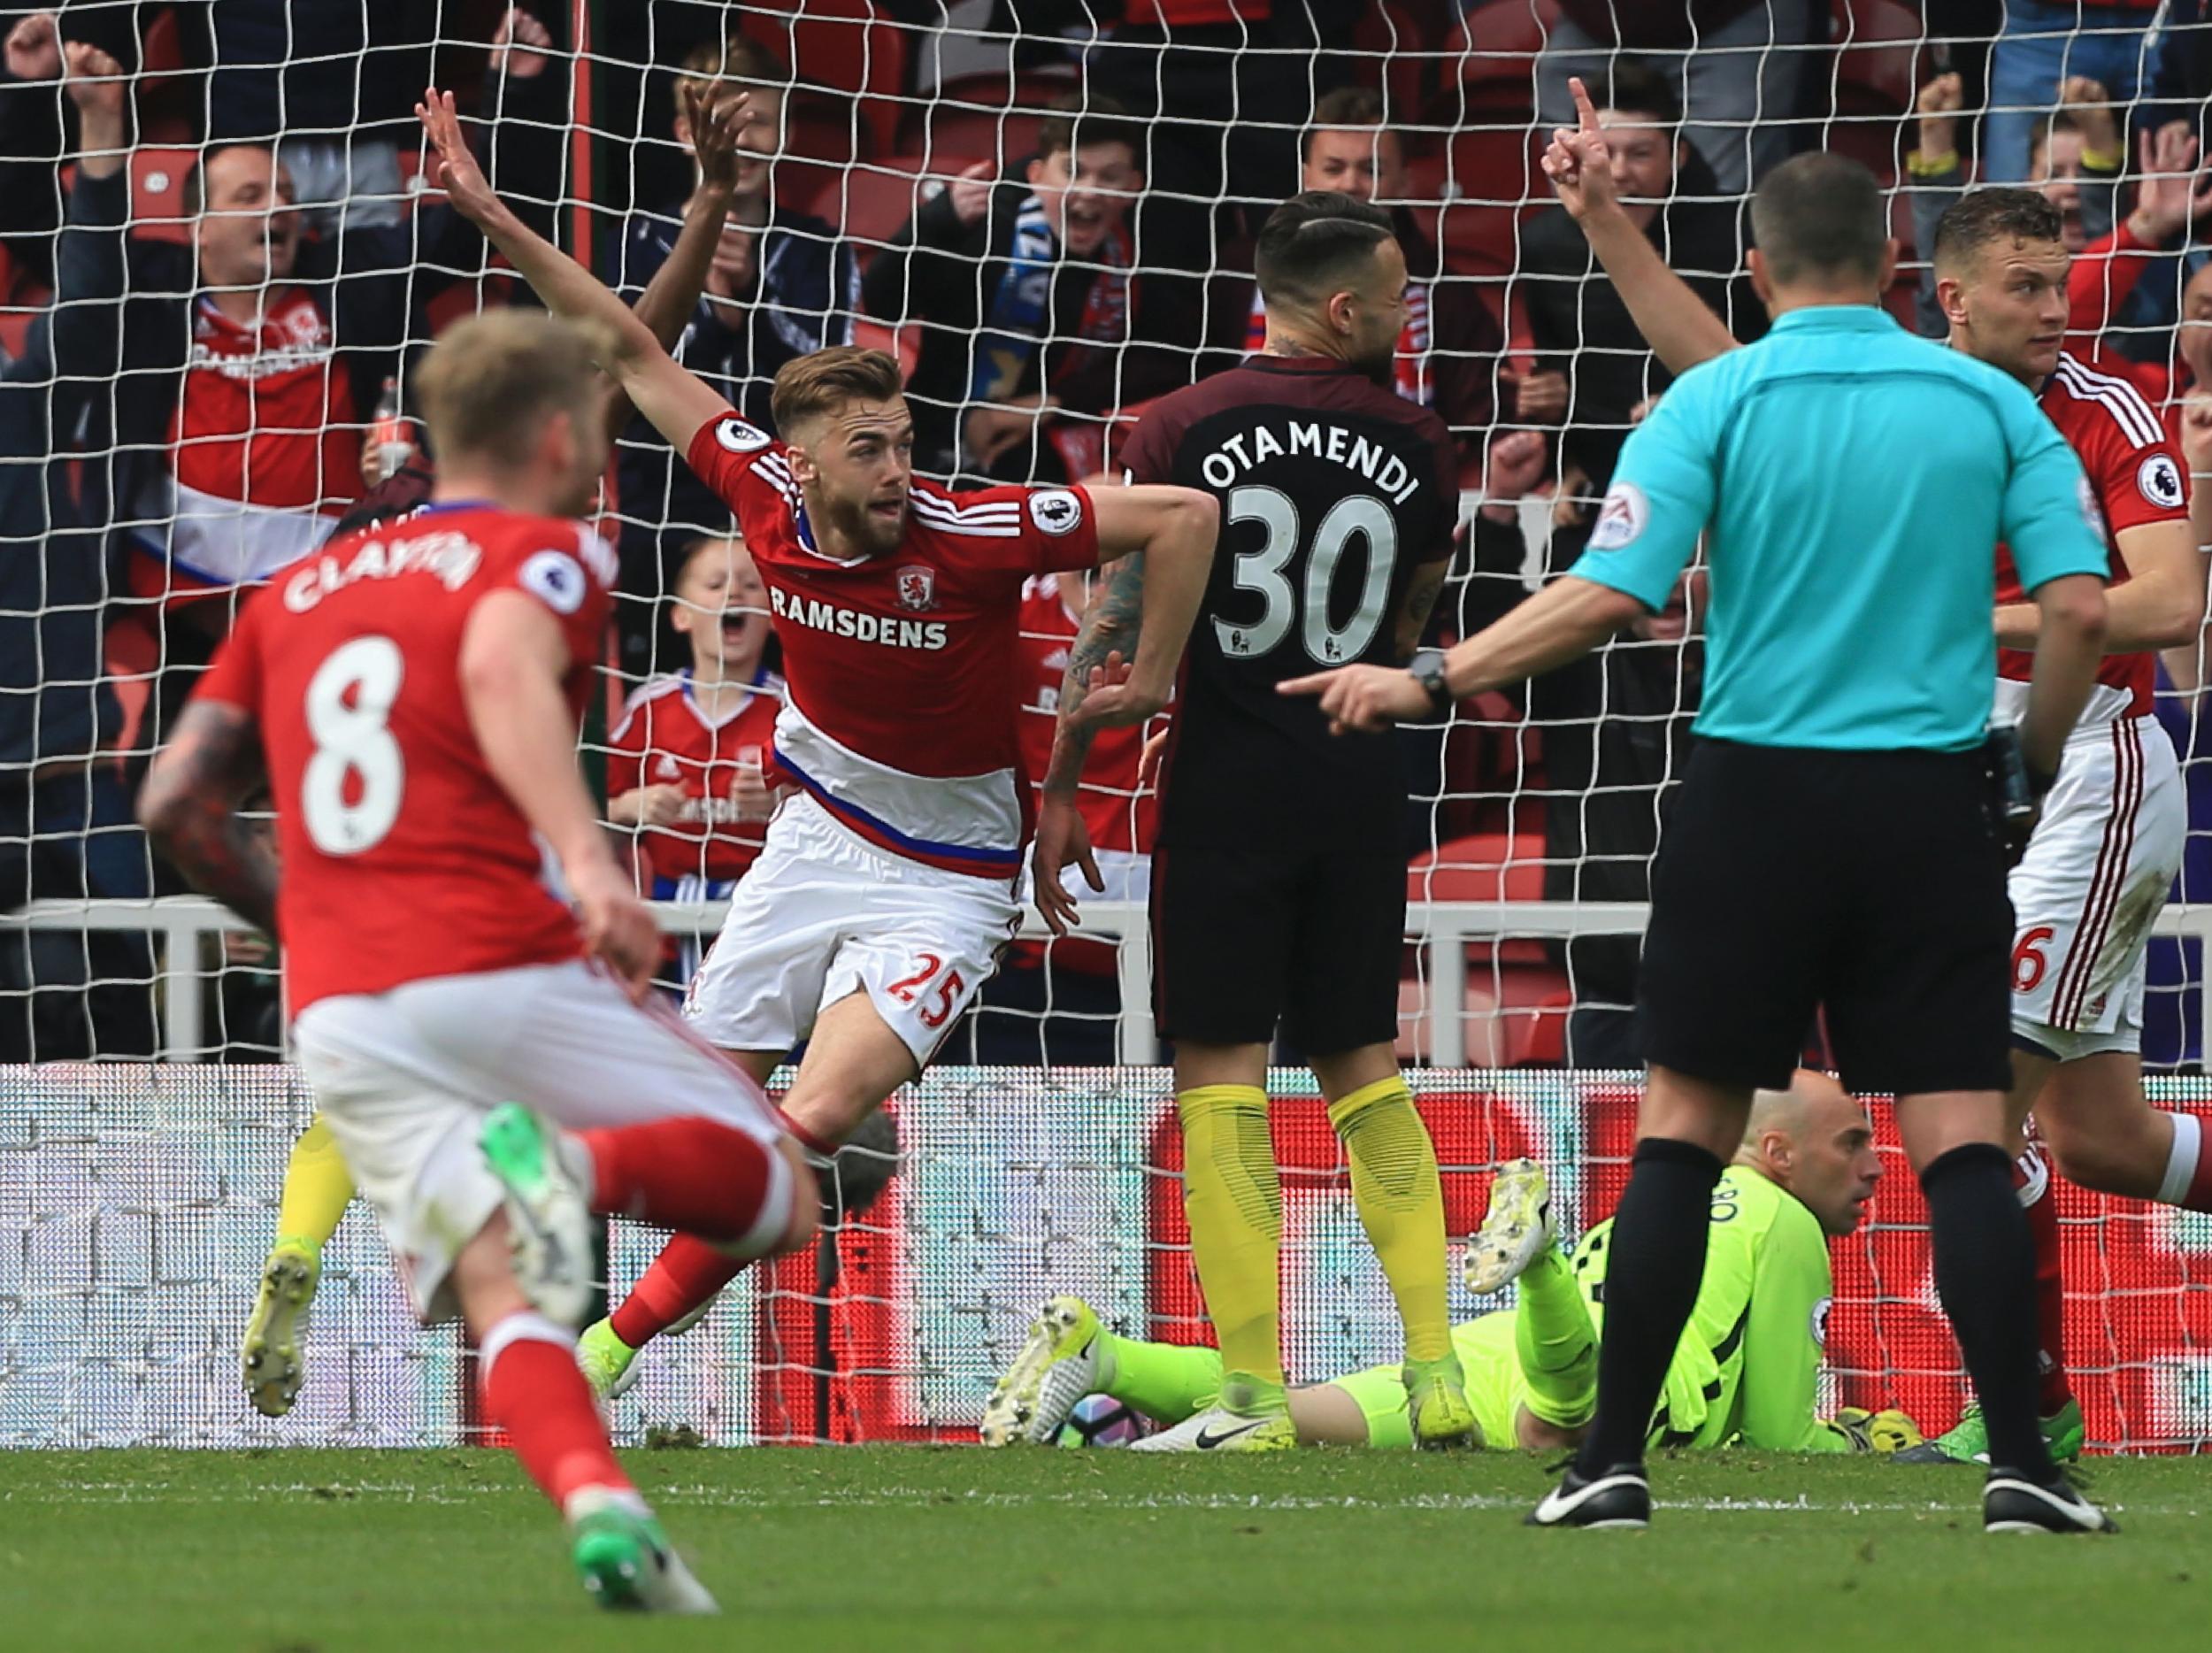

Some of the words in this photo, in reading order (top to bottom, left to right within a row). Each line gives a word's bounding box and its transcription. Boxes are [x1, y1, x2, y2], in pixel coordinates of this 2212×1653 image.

[1202, 421, 1420, 505] OTAMENDI
[1210, 485, 1399, 666] 30
[770, 585, 948, 650] RAMSDENS
[300, 634, 406, 857] 8
[886, 953, 964, 1028] 25
[2010, 926, 2054, 993] 6
